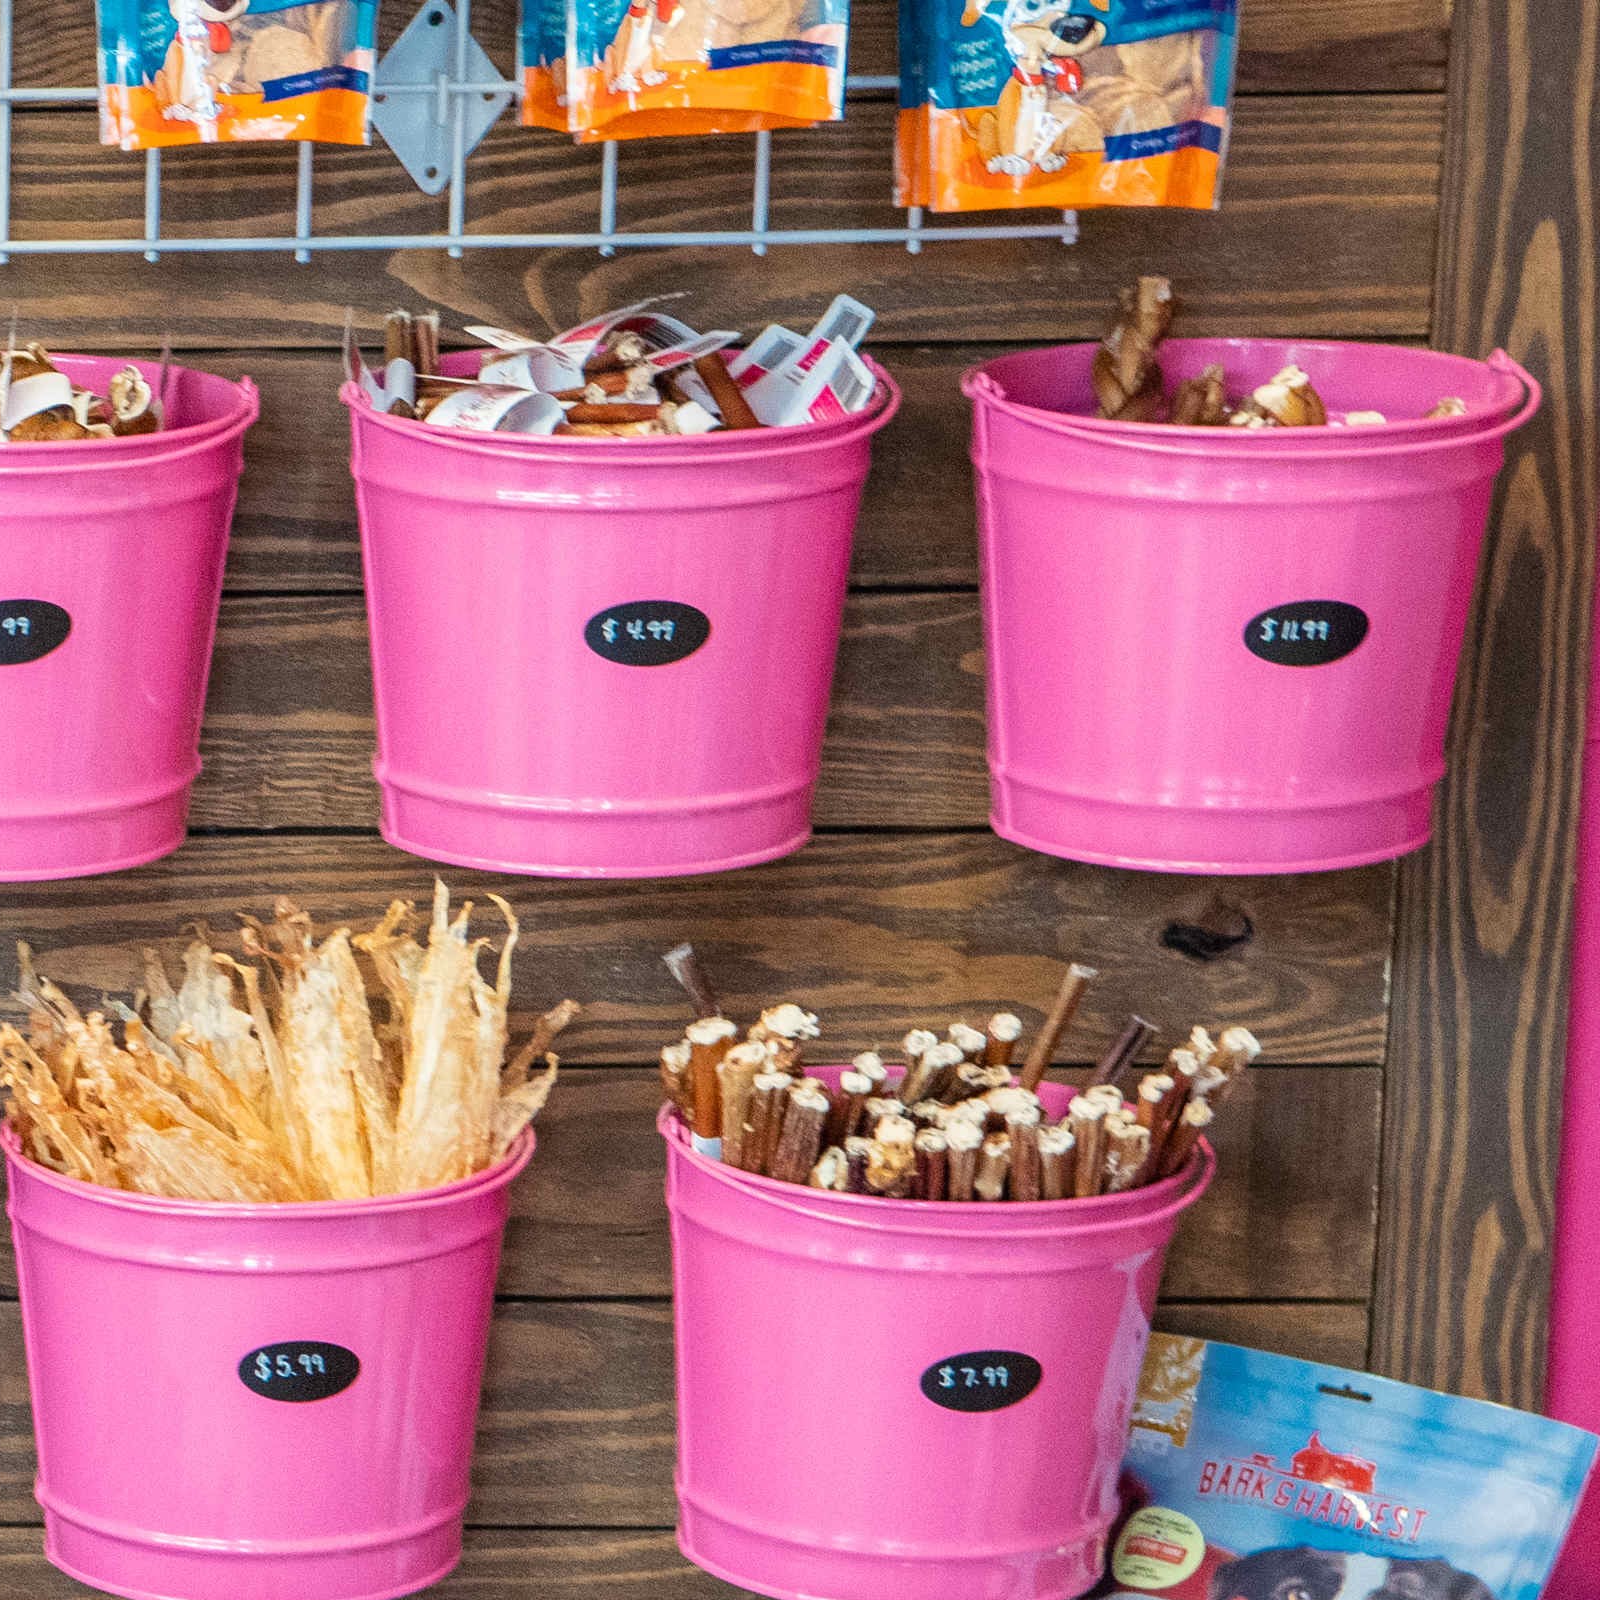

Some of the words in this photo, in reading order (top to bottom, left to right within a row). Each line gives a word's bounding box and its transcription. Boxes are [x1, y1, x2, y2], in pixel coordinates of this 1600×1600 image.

[602, 617, 676, 644] $4.99
[1260, 617, 1330, 643] $11.99
[254, 1351, 326, 1383] $5.99
[938, 1365, 1009, 1388] $7.99
[1199, 1461, 1271, 1500] BARK
[1296, 1488, 1428, 1542] HARVEST
